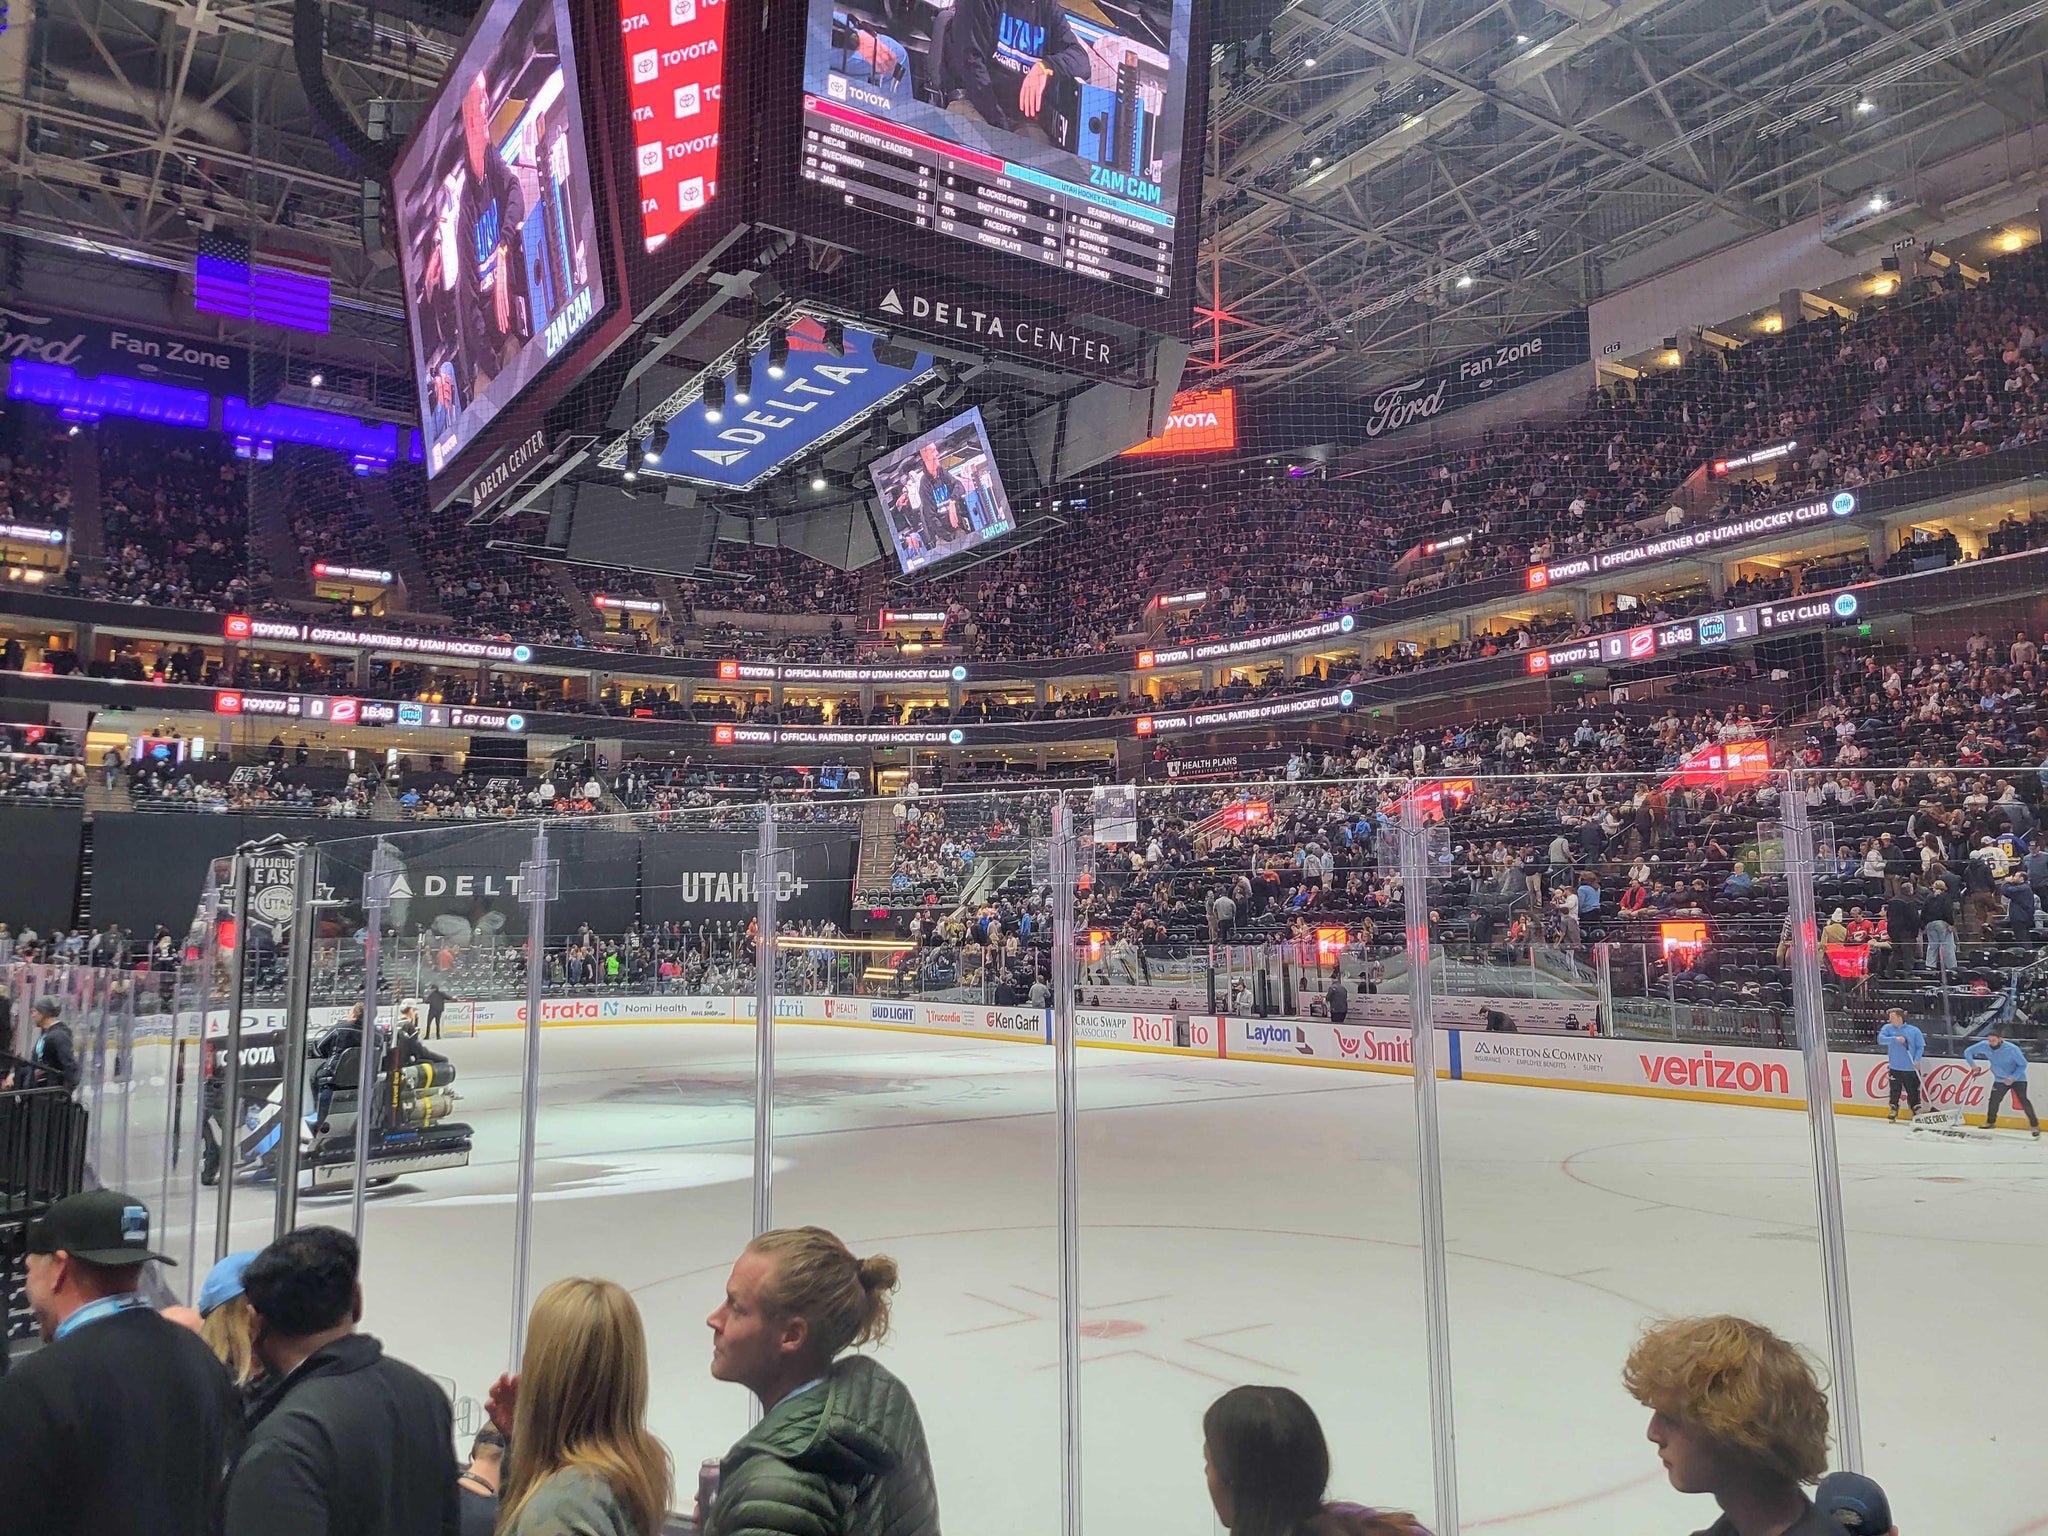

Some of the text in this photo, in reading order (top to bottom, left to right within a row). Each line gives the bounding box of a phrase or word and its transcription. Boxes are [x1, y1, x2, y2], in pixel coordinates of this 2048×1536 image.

[661, 39, 718, 67] TOYOTA
[849, 87, 891, 110] TOYOTA
[822, 133, 847, 150] NECAS
[830, 123, 859, 141] SEASON
[860, 131, 882, 147] POINT
[881, 138, 913, 157] LEADERS
[806, 156, 836, 173] 20 AHO
[807, 143, 865, 168] 37 SVECHNIKOV
[805, 169, 846, 190] 24 JARVIS
[996, 177, 1011, 189] HITS
[1090, 164, 1161, 205] ZAM CAM
[917, 191, 927, 201] 13
[978, 186, 1028, 209] BLOCKED SHOTS
[916, 203, 926, 213] 11
[941, 205, 956, 217] 70%
[977, 201, 1027, 224] SHOT ATTEMPTS
[984, 218, 1012, 234] FACEOFF
[1079, 216, 1102, 230] KELLER
[1087, 206, 1155, 234] SEASON POINT LEADERS
[1067, 225, 1075, 234] 11
[978, 232, 1022, 252] POWER PLAYS
[544, 286, 592, 358] ZAM CAM
[913, 296, 1110, 364] DELTA CENTER
[110, 331, 231, 370] Fan Zone
[1366, 378, 1447, 437] Ford
[1460, 357, 1493, 381] Fan
[1496, 336, 1543, 366] Zone
[717, 364, 869, 445] DELTA
[1164, 412, 1219, 430] OYOTA
[480, 430, 545, 499] DELTA CENTER
[1548, 499, 1851, 578] TOYOTA OFFICIAL PARTNER OF UTAH HOCKEY CLUB UTAH
[1799, 602, 1831, 619] CLUB
[1702, 624, 1723, 637] UTAH
[1736, 615, 1747, 633] 1
[1764, 616, 1772, 627] 8
[251, 622, 512, 657] TOYOTA OFFICIAL PARTNER OF UTAH HOCKEY CLUB
[1155, 651, 1188, 663] TOYOTA
[1197, 644, 1228, 657] OFFICIAL
[1229, 639, 1261, 652] PARTNER
[1262, 636, 1272, 646] OF
[1272, 633, 1291, 644] UTAH
[1292, 626, 1321, 640] HOCKEY
[1322, 621, 1340, 633] CLUB
[1659, 628, 1693, 646] 16:49
[1610, 639, 1621, 656] 0
[739, 666, 775, 677] TOYOTA
[785, 669, 821, 678] OFFICIAL
[822, 669, 857, 679] PARTNER
[859, 670, 872, 679] OF
[872, 670, 893, 679] UTAH
[894, 669, 928, 679] HOCKEY
[928, 669, 950, 678] CLUB
[311, 700, 324, 715] 0
[430, 709, 441, 723] 1
[1153, 718, 1187, 729] TOYOTA
[1195, 713, 1227, 725] OFFICIAL
[1228, 707, 1260, 720] PARTNER
[1260, 706, 1271, 716] OF
[1271, 704, 1290, 715] UTAH
[1291, 698, 1320, 711] HOCKEY
[1321, 695, 1339, 706] CLUB
[480, 715, 505, 727] CLUB
[734, 731, 771, 741] TOYOTA
[781, 733, 816, 742] OFFICIAL
[818, 733, 854, 742] PARTNER
[855, 733, 867, 742] OF
[868, 733, 889, 742] UTAH
[891, 733, 925, 742] HOCKEY
[926, 732, 947, 742] CLUB
[1182, 756, 1238, 770] HEALTH PLANS
[424, 875, 525, 896] DELT
[682, 872, 748, 902] UTAH
[517, 1001, 598, 1021] etrata
[625, 1003, 688, 1013] Nomi Health
[836, 1002, 858, 1014] HEALTH
[872, 1006, 914, 1021] BUD LIGHT
[995, 1012, 1014, 1029] Ken
[1015, 1014, 1039, 1031] Garff
[1100, 1015, 1127, 1029] SWAPP
[1080, 1028, 1118, 1039] ASSOCIATES
[1245, 1022, 1291, 1045] Layton
[1492, 1044, 1540, 1058] MORETON
[1474, 1055, 1604, 1072] INSURANCE EMPLOYEE BENEFITS SURETY
[1640, 1050, 1789, 1094] verizon
[1924, 1113, 1948, 1125] ICE CREW
